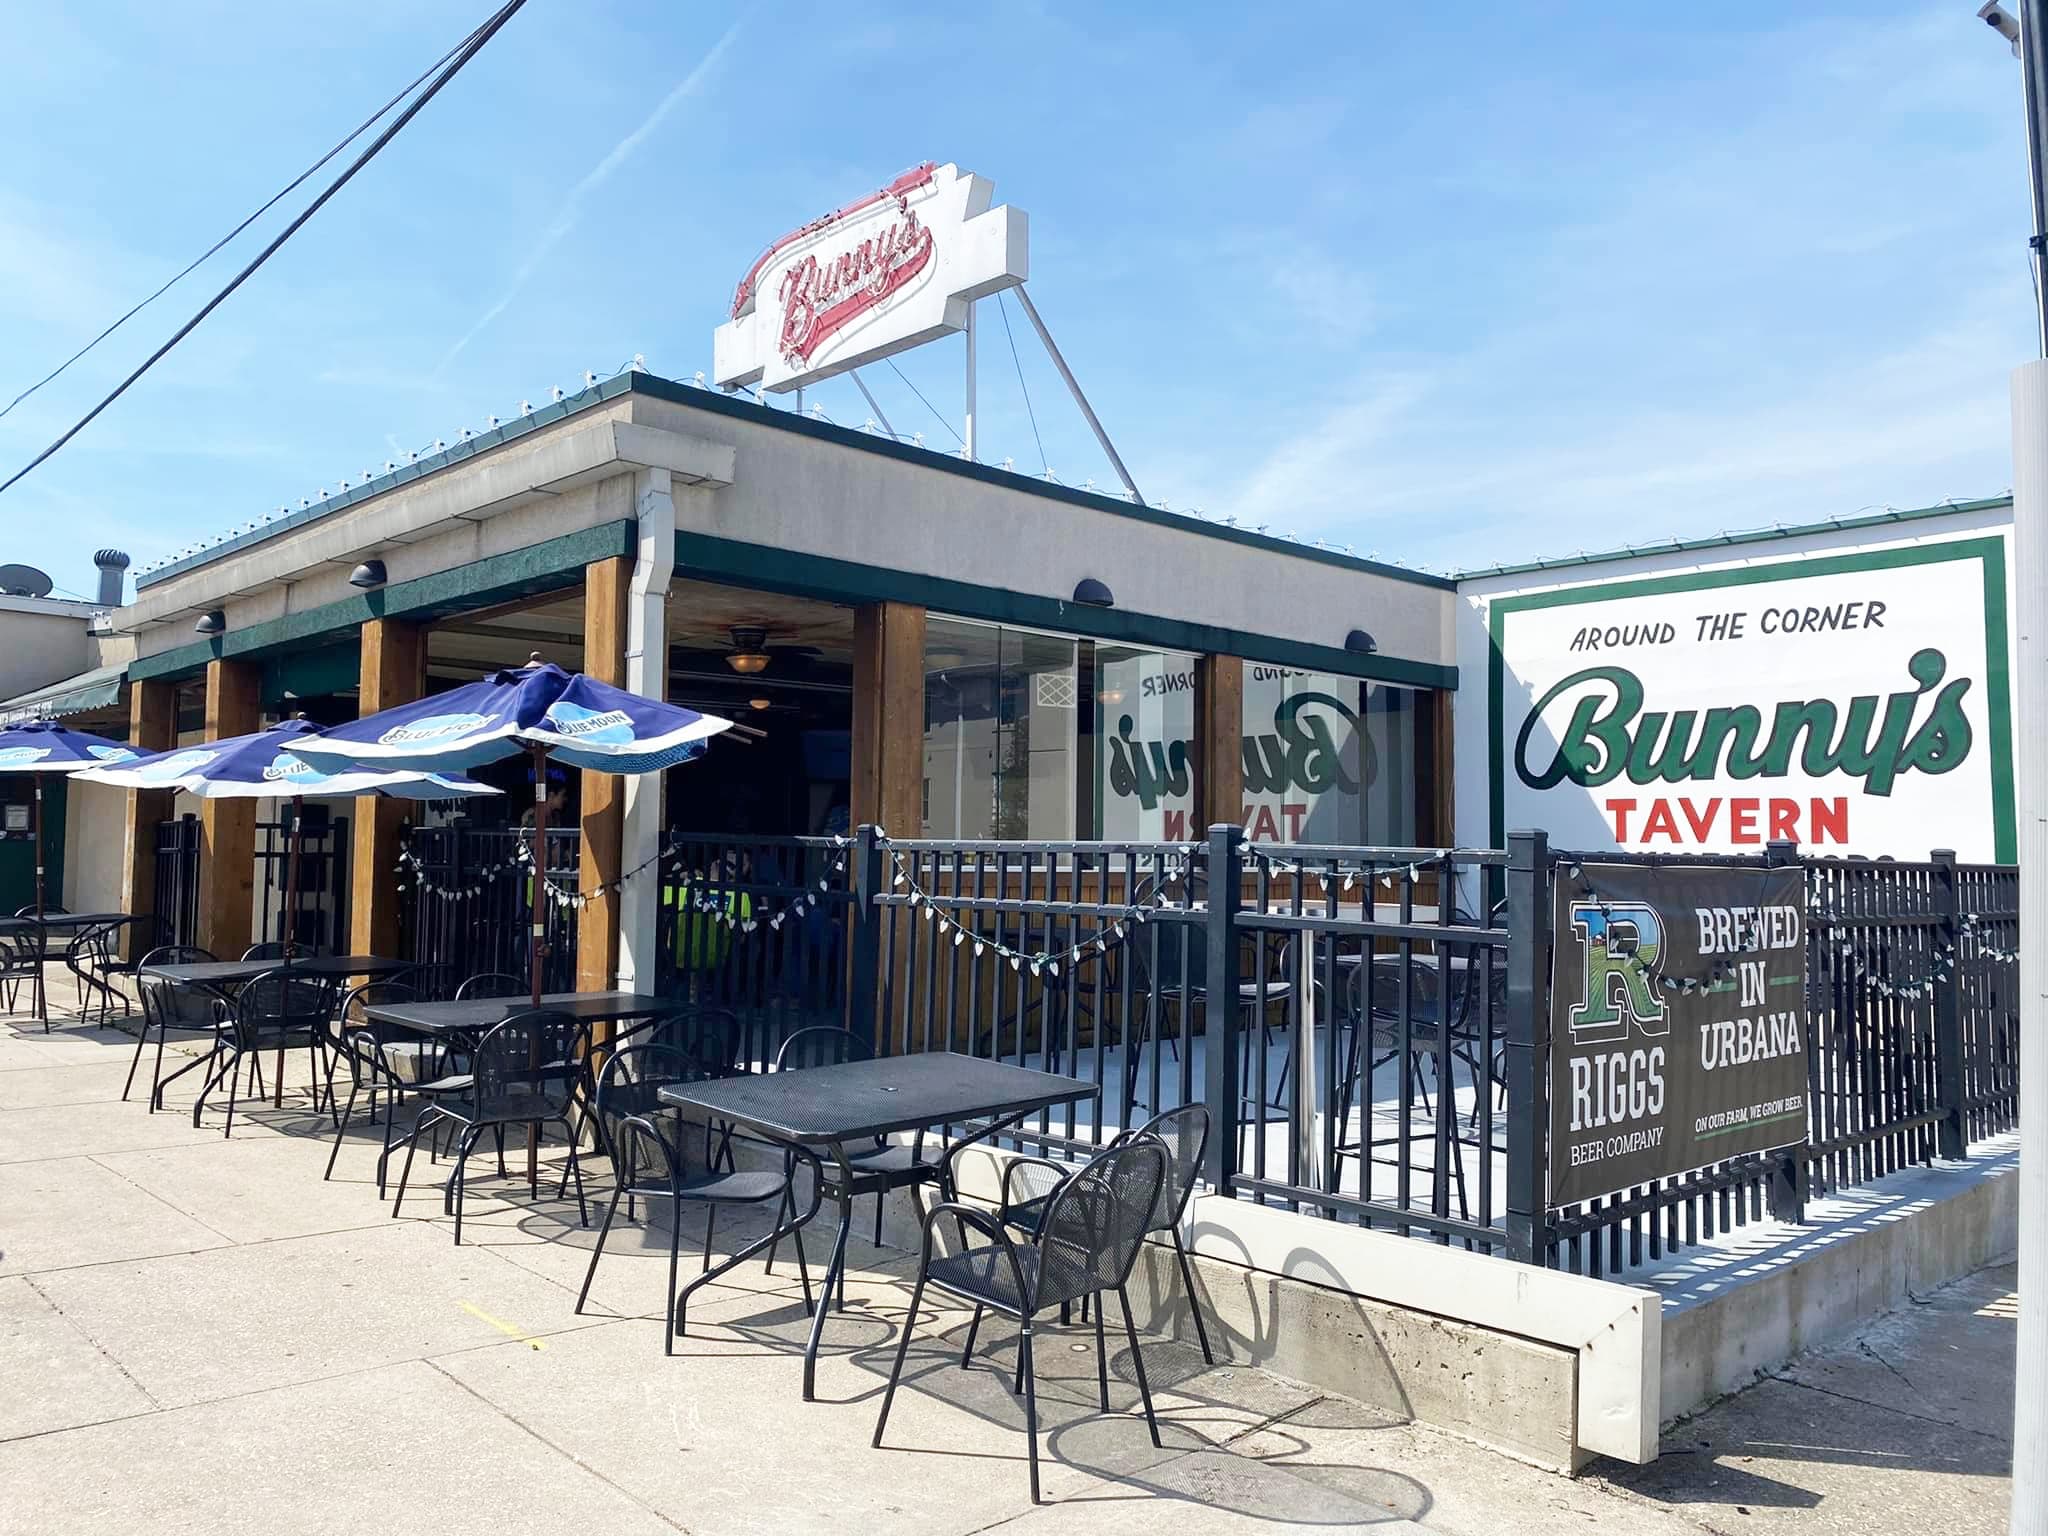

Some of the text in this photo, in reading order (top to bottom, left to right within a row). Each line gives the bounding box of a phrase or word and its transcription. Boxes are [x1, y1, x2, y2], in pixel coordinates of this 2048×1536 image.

[1569, 601, 1887, 652] AROUND THE CORNER
[1514, 648, 1973, 798] Bunny's
[1606, 797, 1849, 844] TAVERN
[1695, 905, 1800, 955] BREWED
[1739, 960, 1767, 1008] IN
[1700, 1010, 1801, 1072] URBANA
[1569, 1046, 1665, 1132] RIGGS
[1695, 1116, 1708, 1133] ON
[1708, 1111, 1727, 1130] OUR
[1749, 1103, 1763, 1120] WE
[1762, 1099, 1785, 1117] GROW
[1570, 1126, 1664, 1167] BEER COMPANY
